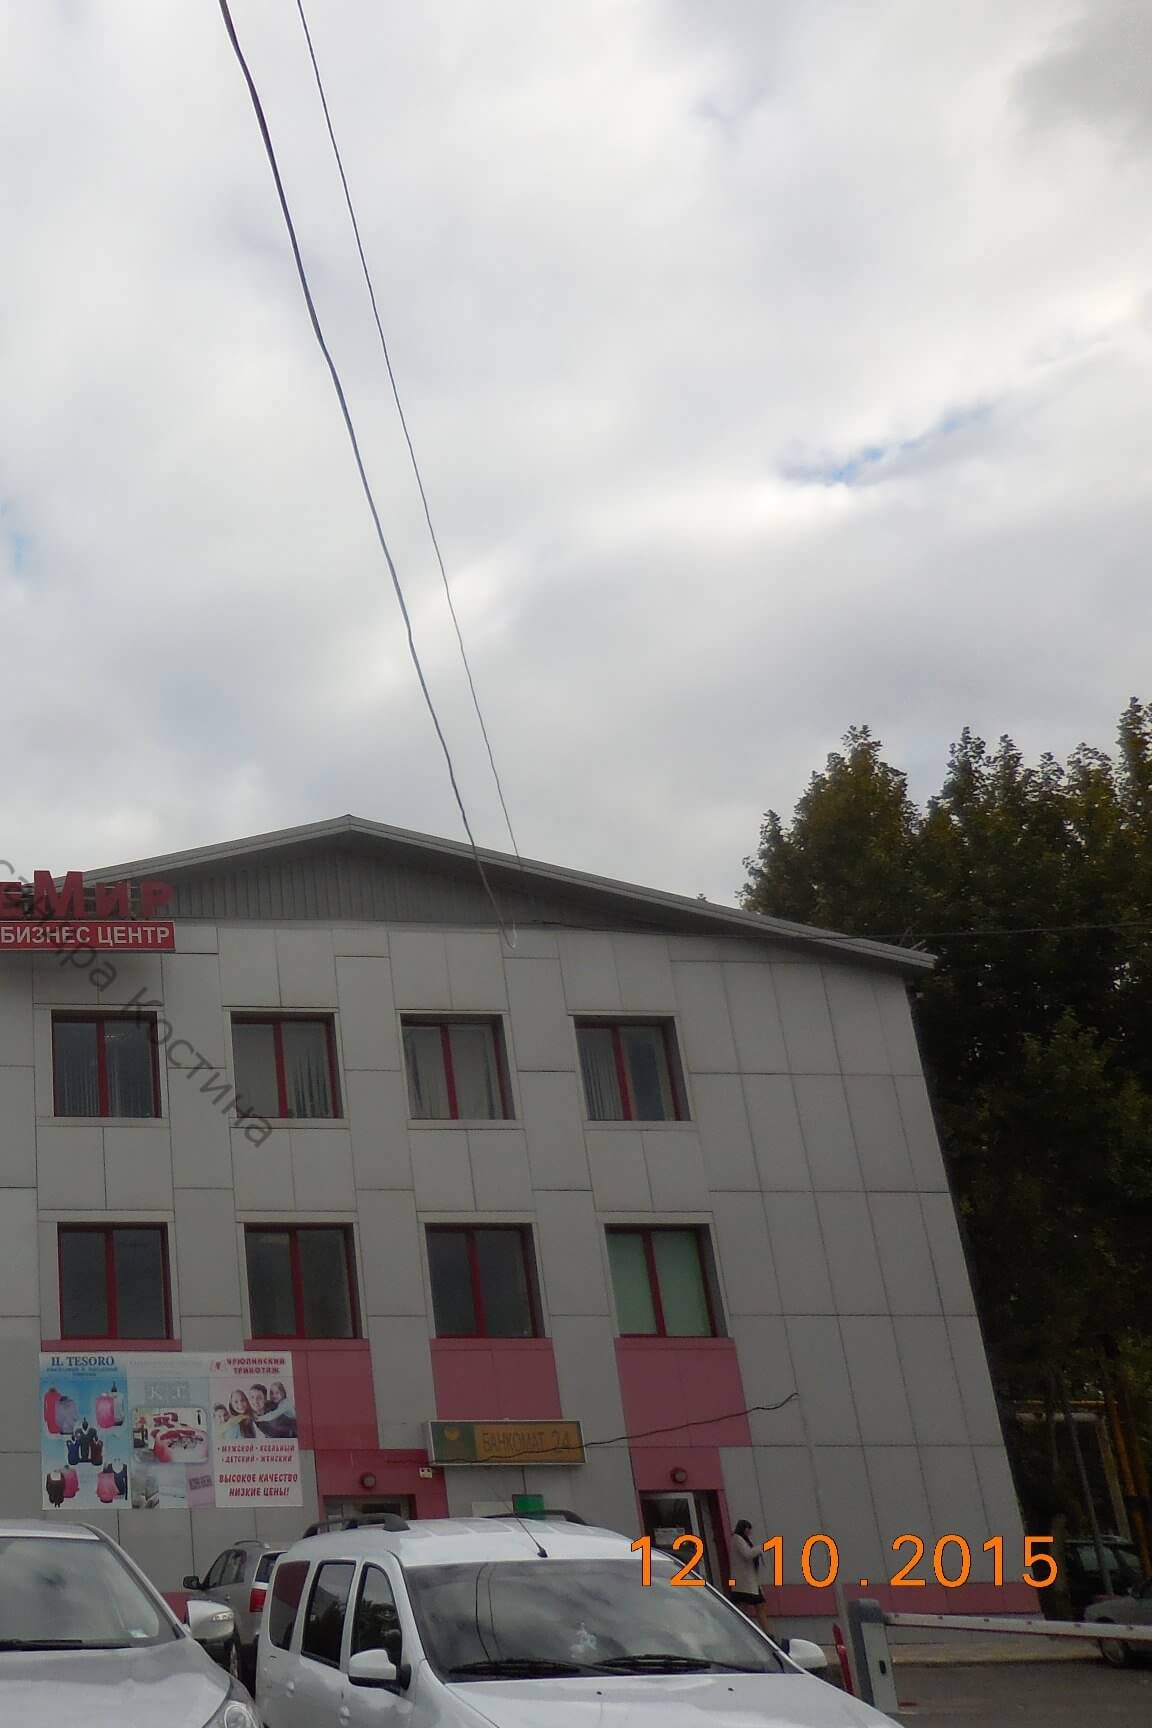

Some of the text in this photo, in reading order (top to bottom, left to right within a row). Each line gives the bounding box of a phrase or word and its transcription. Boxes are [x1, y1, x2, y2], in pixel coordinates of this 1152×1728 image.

[0, 926, 170, 946] БИЗНЕС ЦЕНТР
[51, 1356, 63, 1366] IL
[66, 1355, 115, 1367] TESORO
[219, 1474, 256, 1483] ВЫСОКОЕ
[259, 1473, 298, 1483] КАЧЕСТВО
[229, 1487, 289, 1497] НИЗКИЕ ЦЕНЫ!
